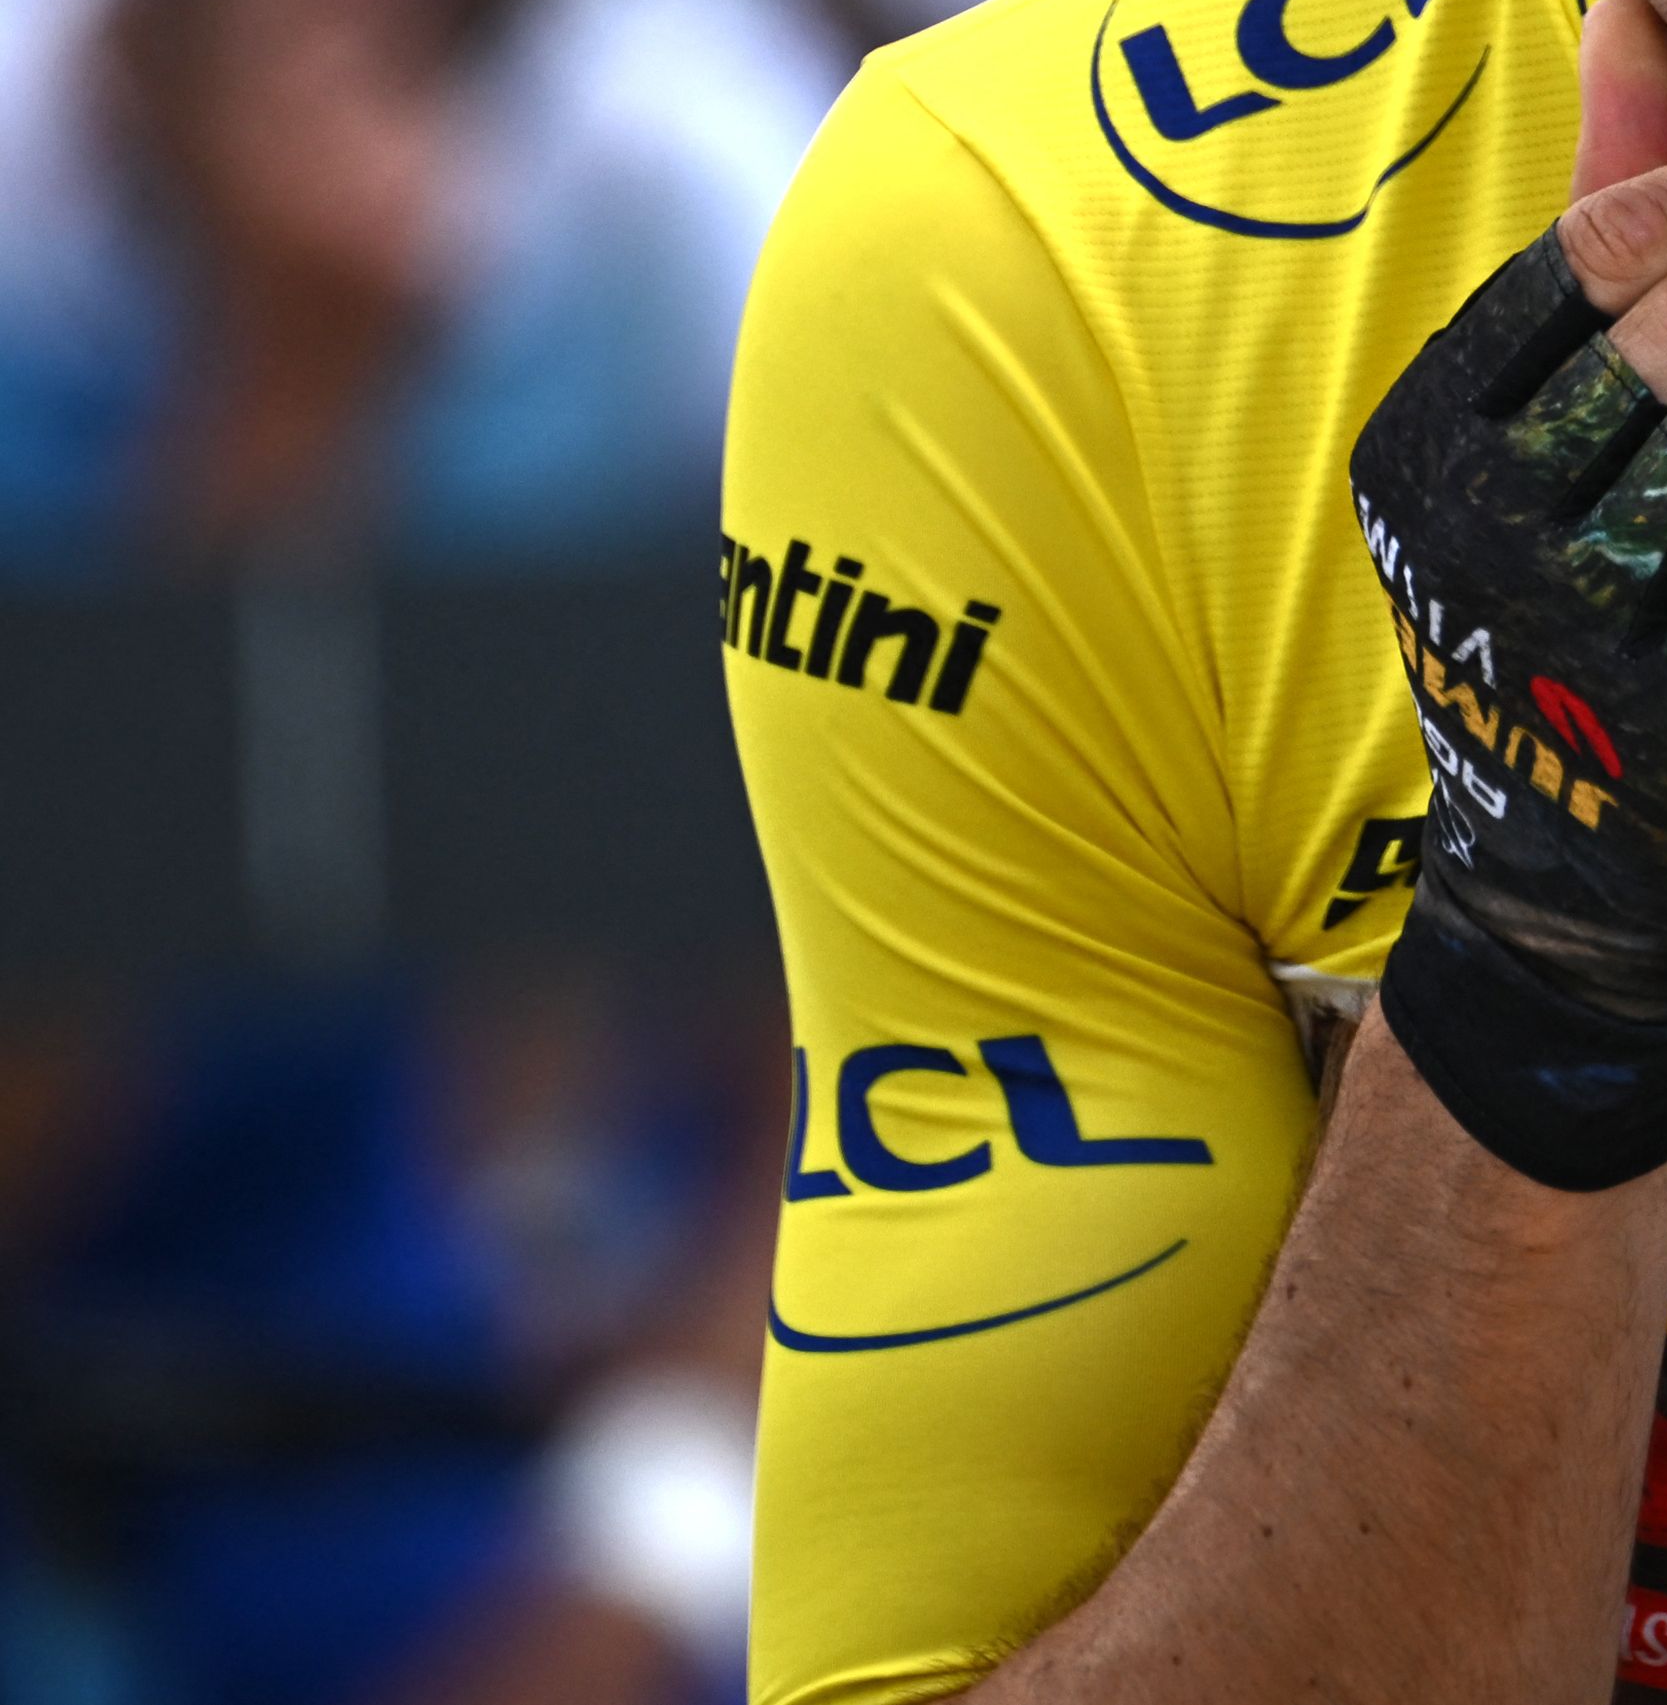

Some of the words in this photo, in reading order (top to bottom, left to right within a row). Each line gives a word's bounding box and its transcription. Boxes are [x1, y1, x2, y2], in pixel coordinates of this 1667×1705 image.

[720, 532, 1002, 718] ntini
[1352, 492, 1498, 690] VISM
[782, 1032, 1216, 1204] LCL
